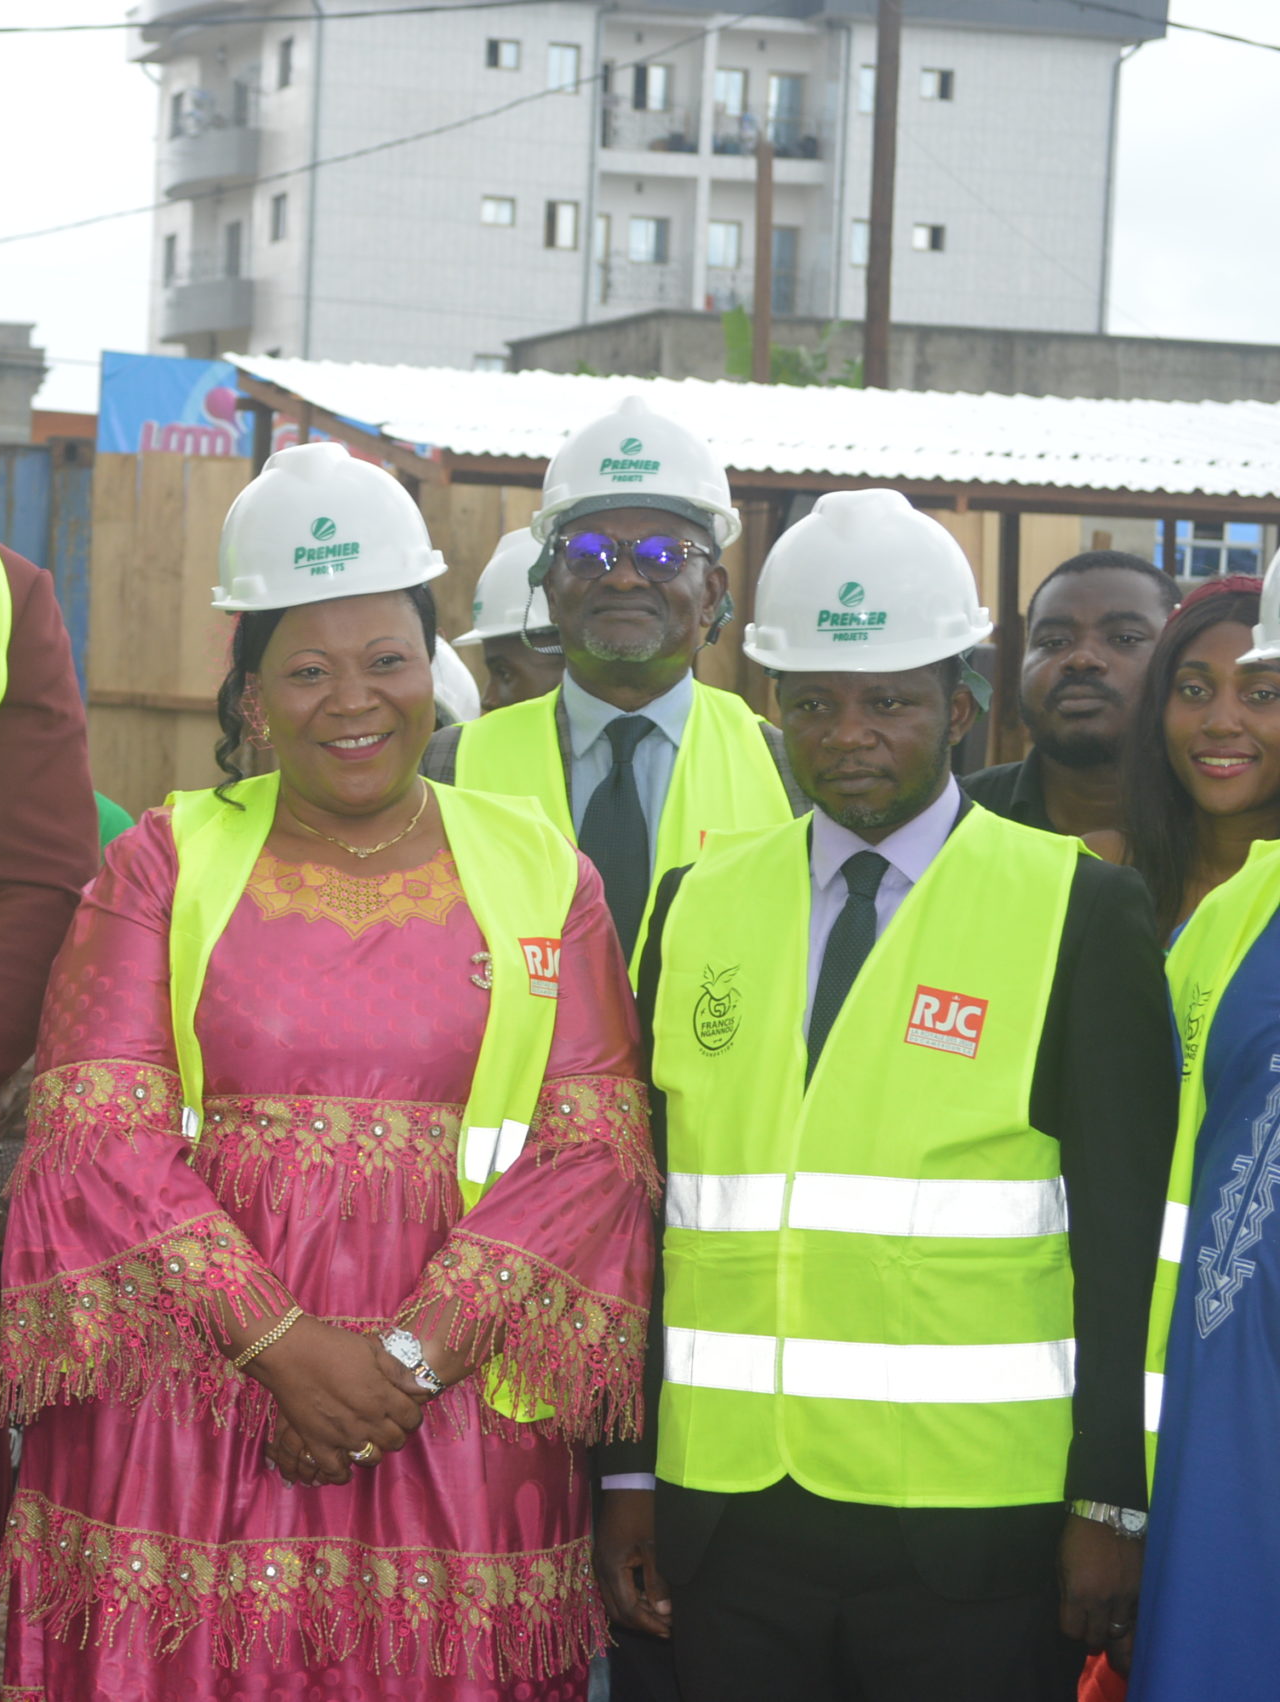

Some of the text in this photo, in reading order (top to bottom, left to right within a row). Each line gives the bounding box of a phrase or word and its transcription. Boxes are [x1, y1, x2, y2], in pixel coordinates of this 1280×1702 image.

[600, 458, 661, 472] PREMIER
[294, 542, 360, 564] PREMIER
[311, 562, 345, 576] PROTS
[911, 993, 982, 1038] RJC
[701, 1017, 735, 1030] FRANCIS
